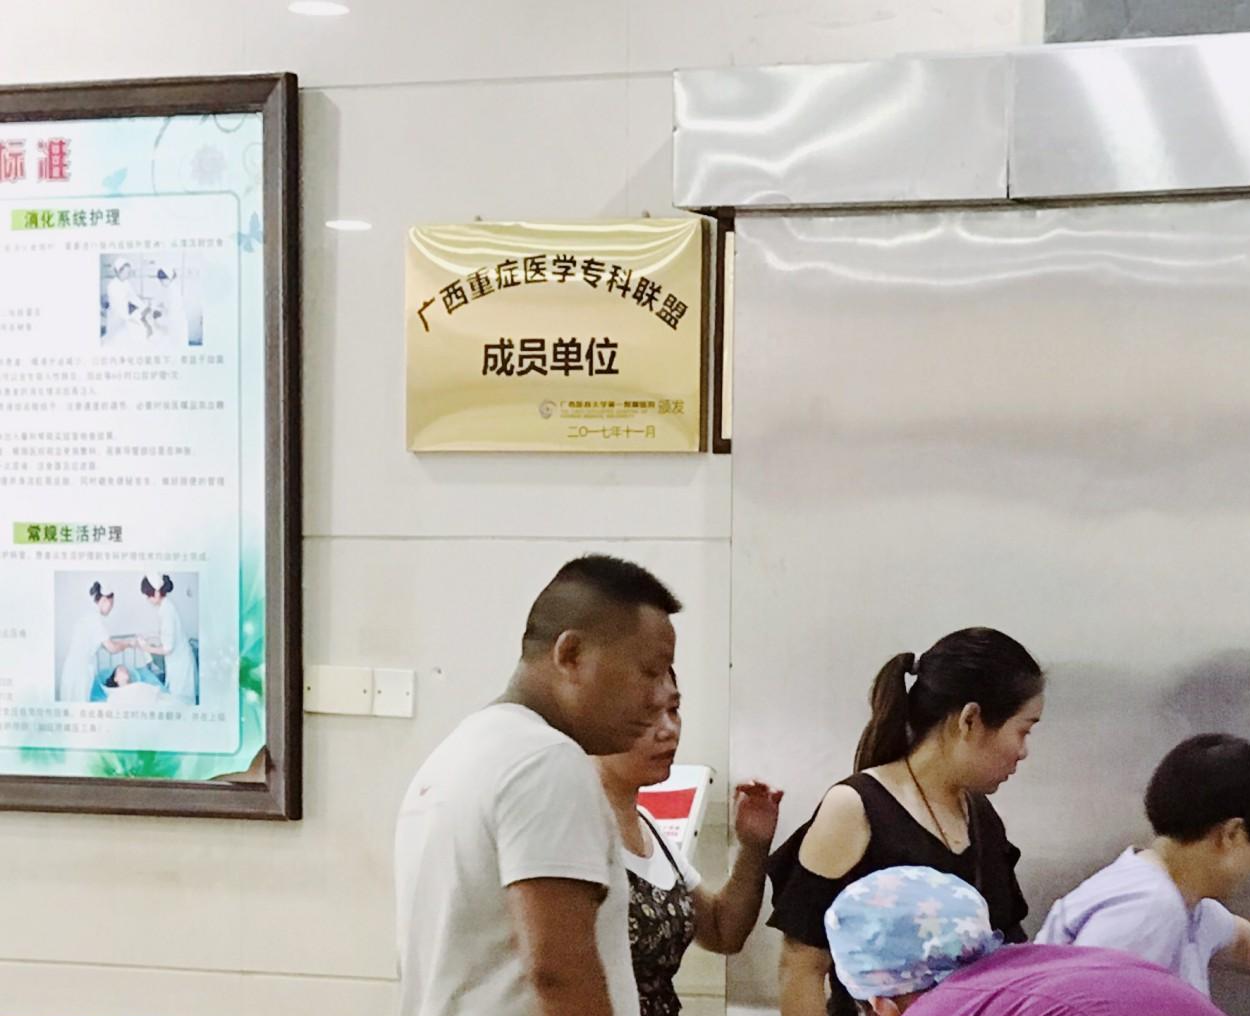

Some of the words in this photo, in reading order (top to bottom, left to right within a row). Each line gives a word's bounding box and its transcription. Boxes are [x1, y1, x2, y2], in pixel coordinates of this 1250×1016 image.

[24, 208, 121, 229] 消化系统护理
[416, 254, 689, 332] 广西重症医学专科联盟
[482, 337, 620, 377] 成员单位
[27, 525, 124, 543] 常规生活护理
